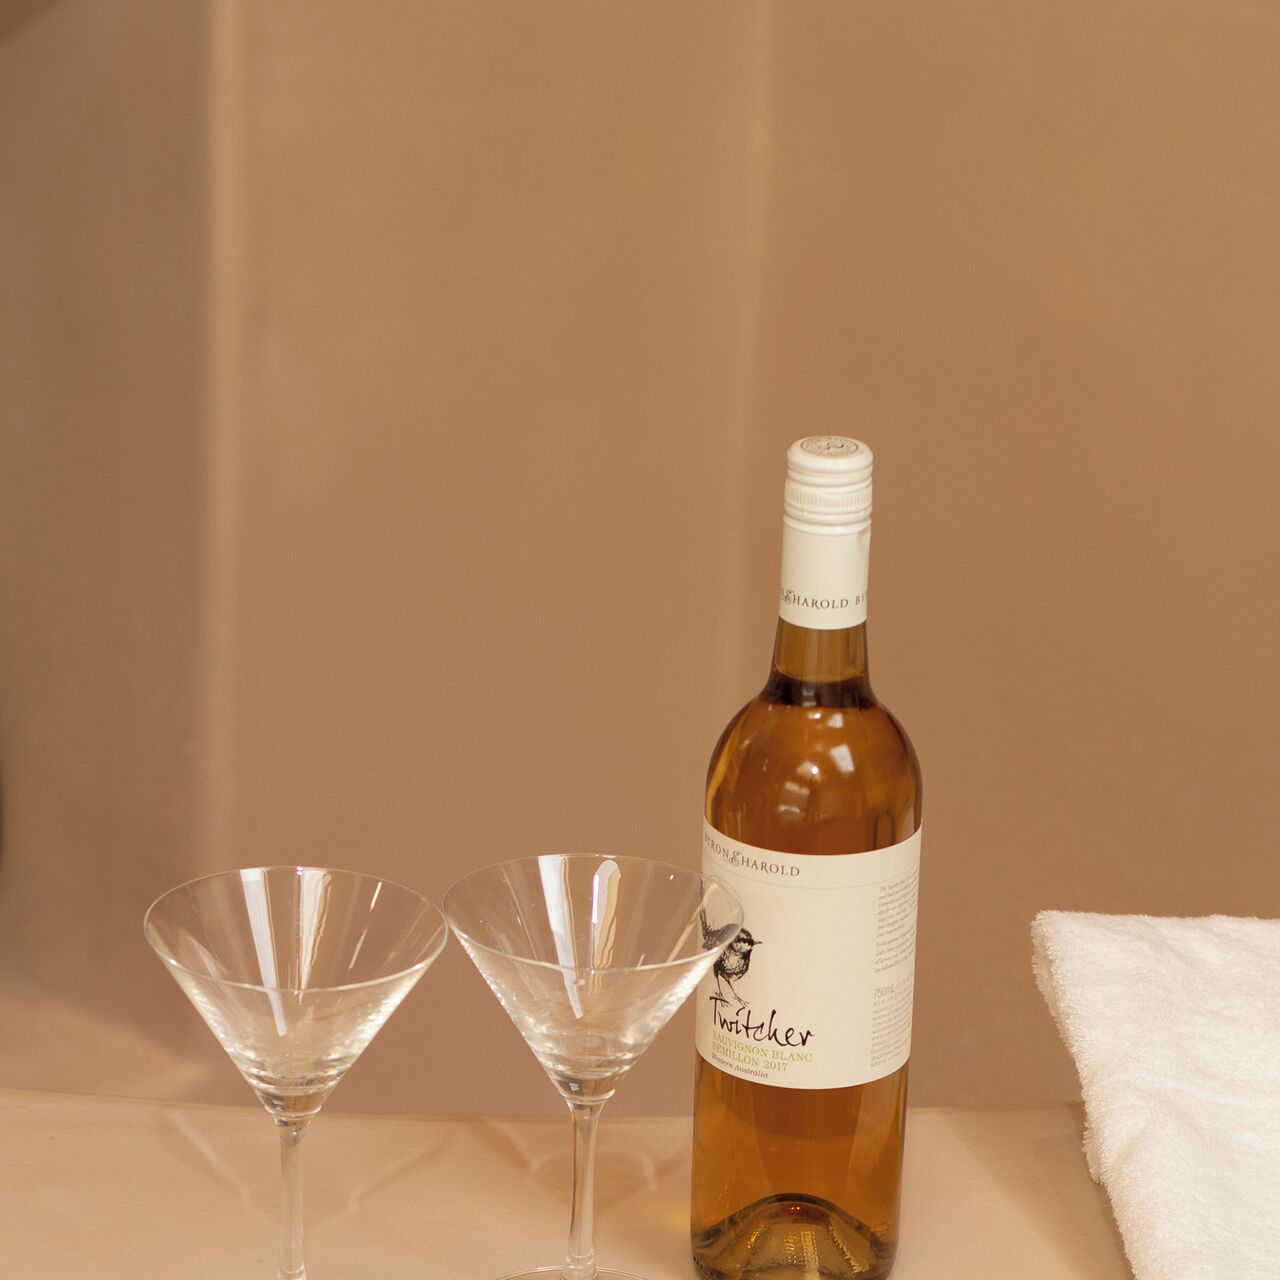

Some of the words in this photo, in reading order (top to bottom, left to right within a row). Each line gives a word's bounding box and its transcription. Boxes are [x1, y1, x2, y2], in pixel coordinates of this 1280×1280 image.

[709, 996, 815, 1046] Twitcher
[712, 1030, 768, 1057] SAUVIGNON
[772, 1050, 812, 1062] BLANC
[712, 1041, 760, 1066] SEMILLON
[763, 1060, 789, 1072] 2017
[734, 1064, 768, 1079] Australia
